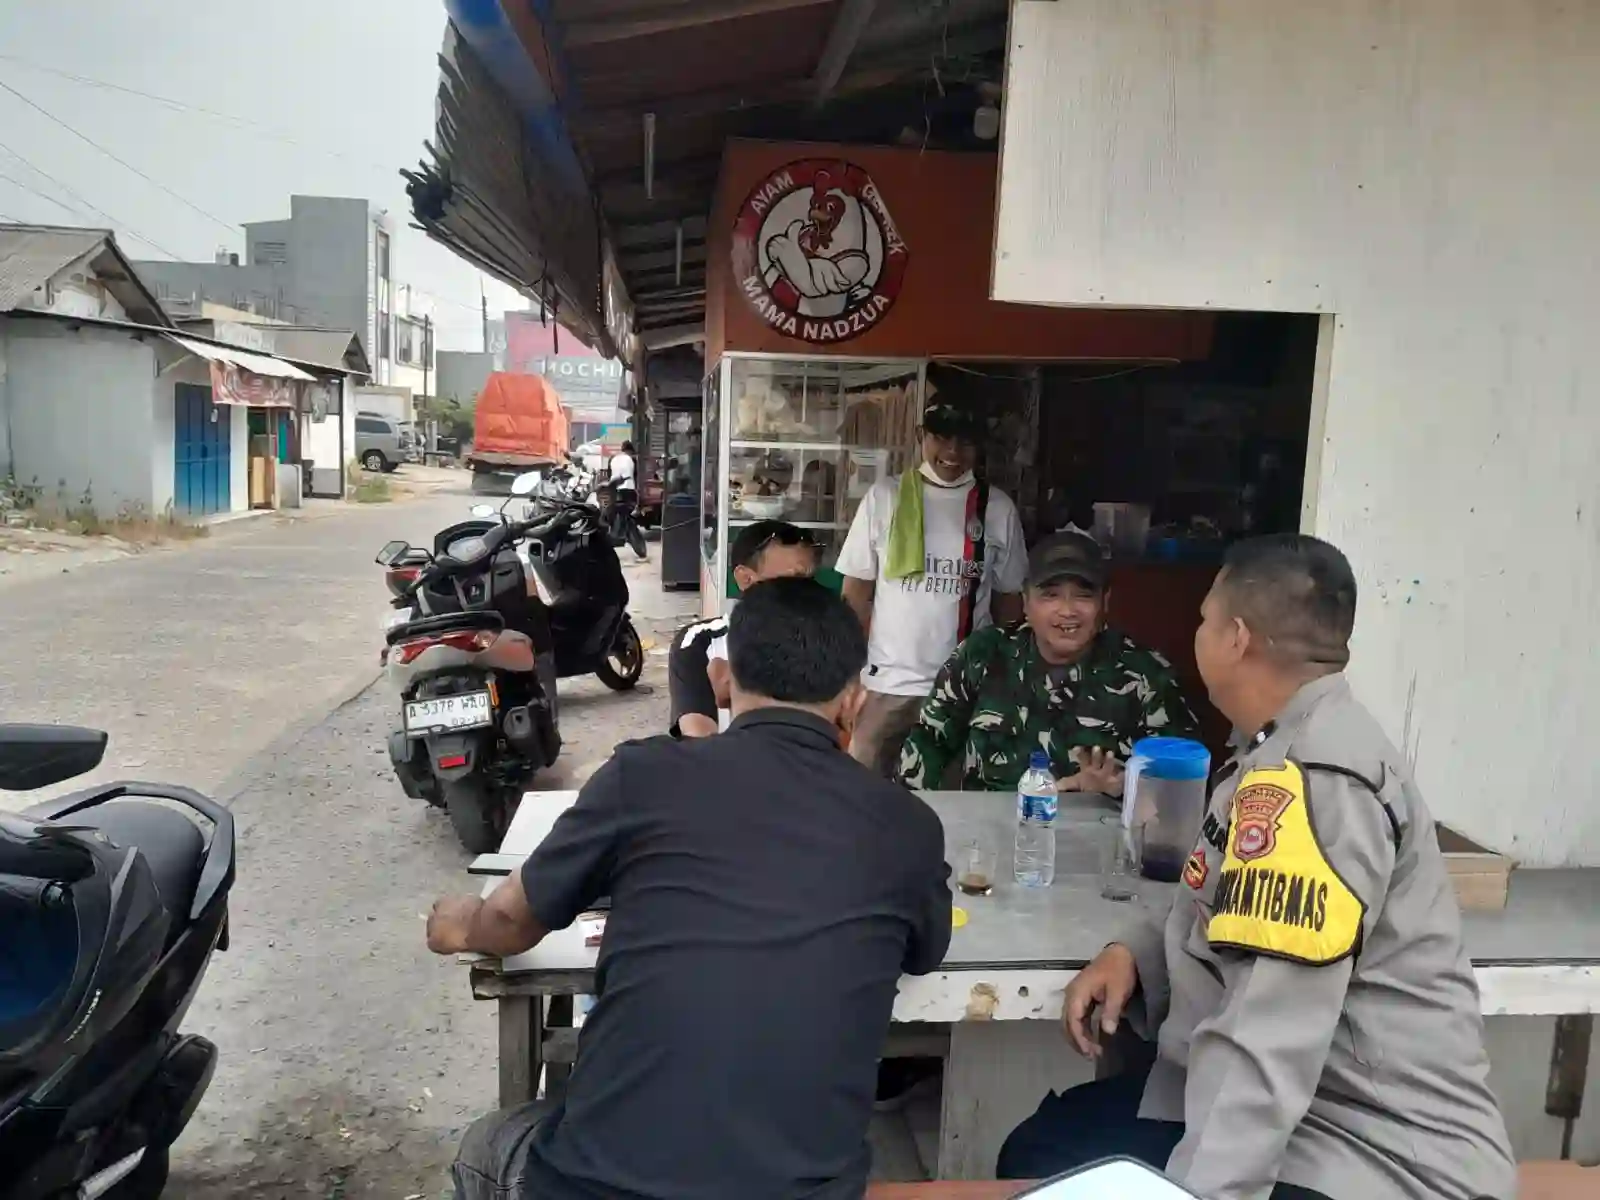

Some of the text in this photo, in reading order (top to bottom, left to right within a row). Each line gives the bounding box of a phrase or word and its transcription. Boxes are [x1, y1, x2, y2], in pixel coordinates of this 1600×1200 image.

[751, 171, 795, 215] AYAM
[743, 276, 889, 340] MAMA NADZUA
